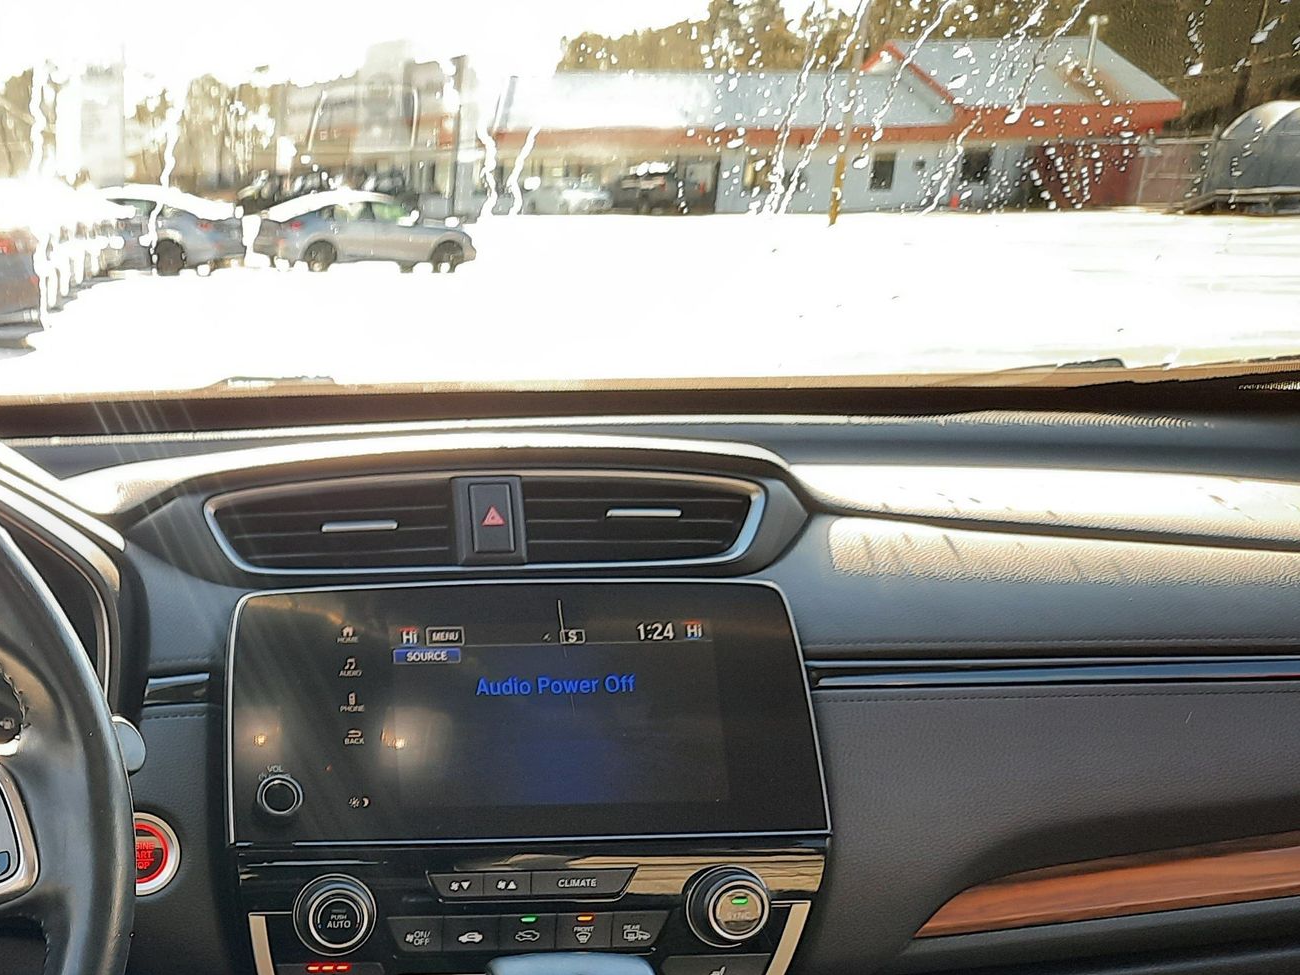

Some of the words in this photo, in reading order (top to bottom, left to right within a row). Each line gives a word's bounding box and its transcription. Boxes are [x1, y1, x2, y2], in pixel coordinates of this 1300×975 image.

[637, 622, 675, 640] 1:24
[686, 623, 703, 638] Hi
[402, 629, 418, 644] Hi
[431, 631, 459, 641] MENU
[406, 651, 448, 662] SOURCE
[339, 669, 362, 677] AUDIO
[476, 676, 532, 696] Audio
[537, 675, 599, 694] Power
[604, 673, 635, 693] Off
[344, 737, 365, 745] BACK
[266, 764, 284, 773] VOL
[558, 878, 597, 888] CLIMATE
[326, 920, 351, 929] AUTO
[573, 925, 595, 933] FRONT
